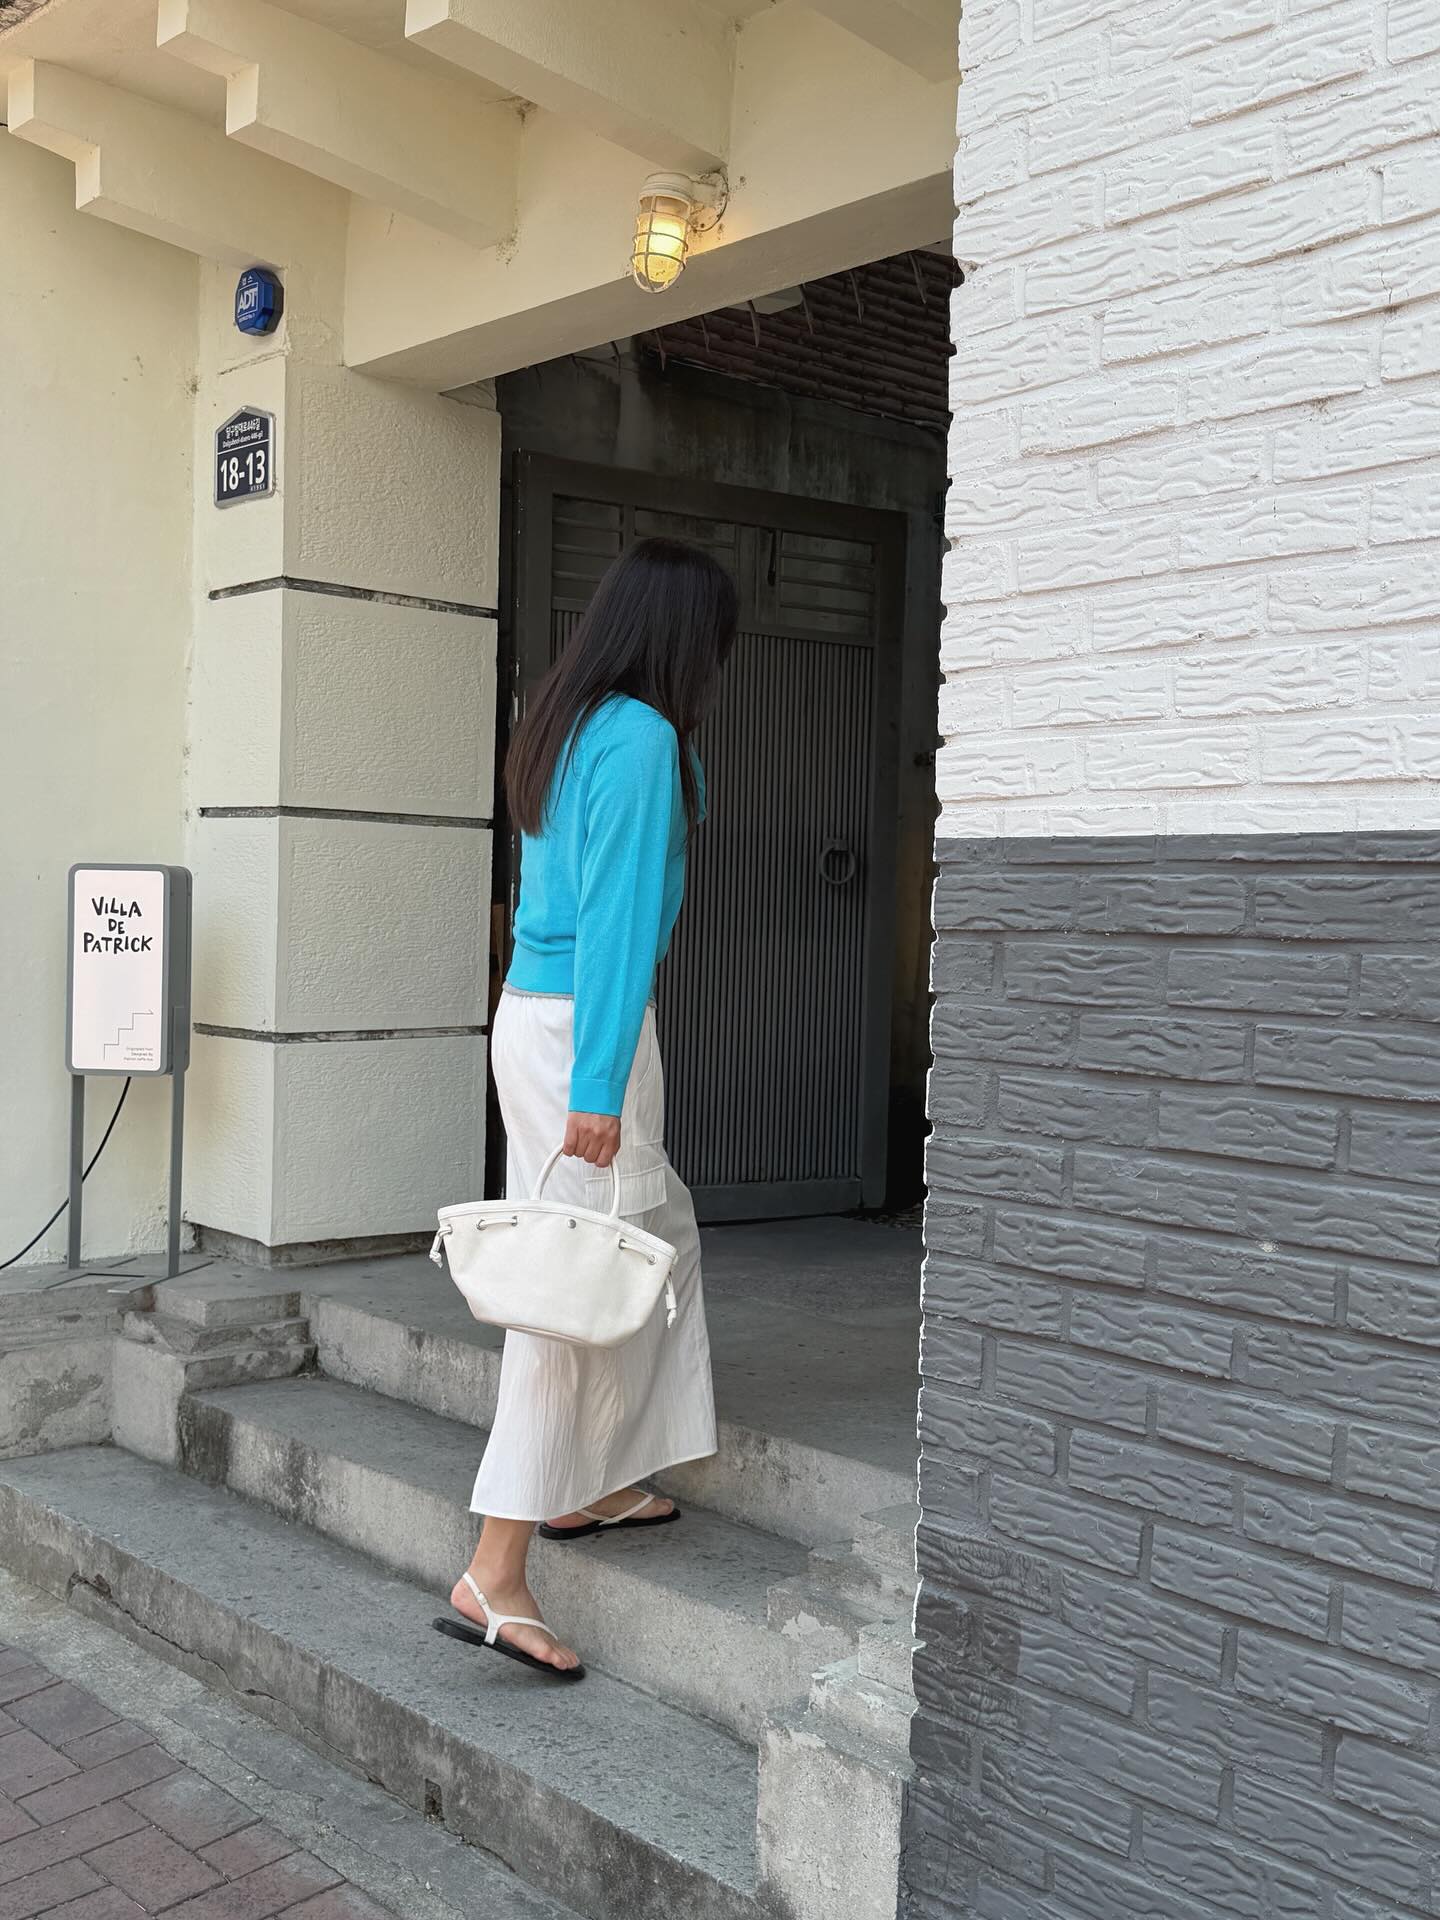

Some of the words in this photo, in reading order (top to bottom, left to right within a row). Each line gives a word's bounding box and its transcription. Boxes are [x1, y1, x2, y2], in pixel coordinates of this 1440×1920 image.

[237, 287, 257, 313] ADT
[220, 449, 265, 492] 18-13
[91, 896, 142, 918] VILLA
[108, 918, 125, 935] DE
[83, 931, 153, 955] PATRICK
